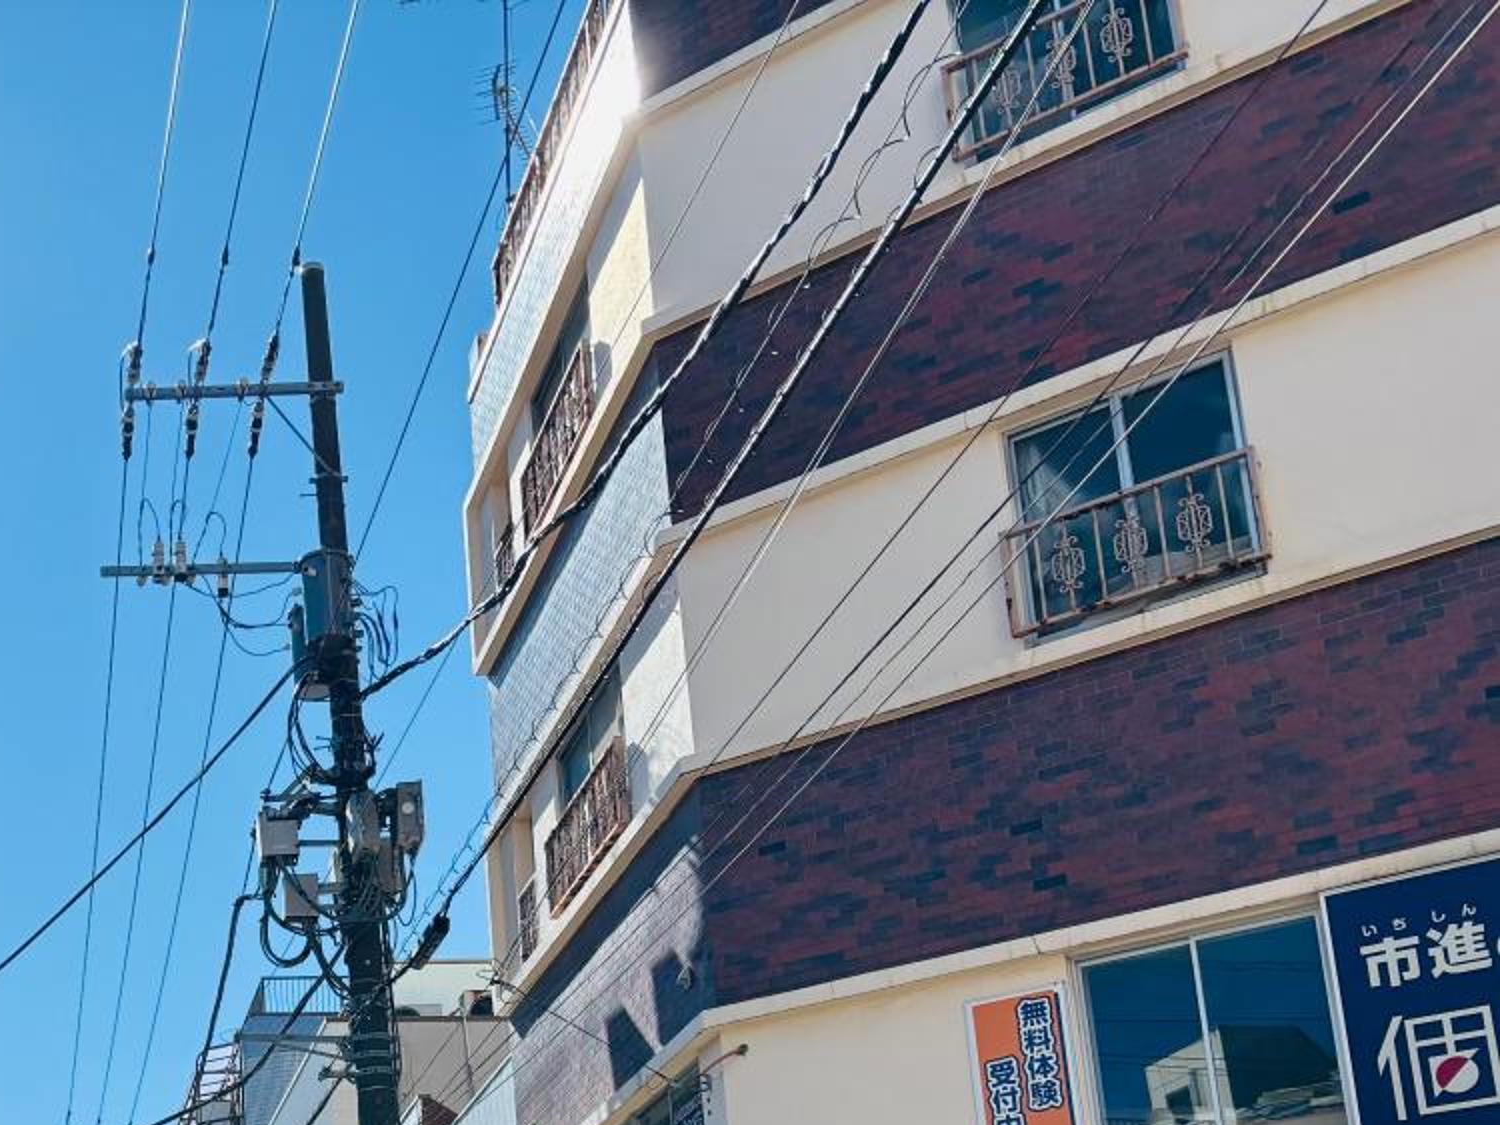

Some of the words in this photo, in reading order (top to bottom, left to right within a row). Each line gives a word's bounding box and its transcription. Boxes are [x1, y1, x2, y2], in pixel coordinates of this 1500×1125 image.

[1360, 921, 1500, 988] 市進
[1018, 1000, 1064, 1110] 無料体験
